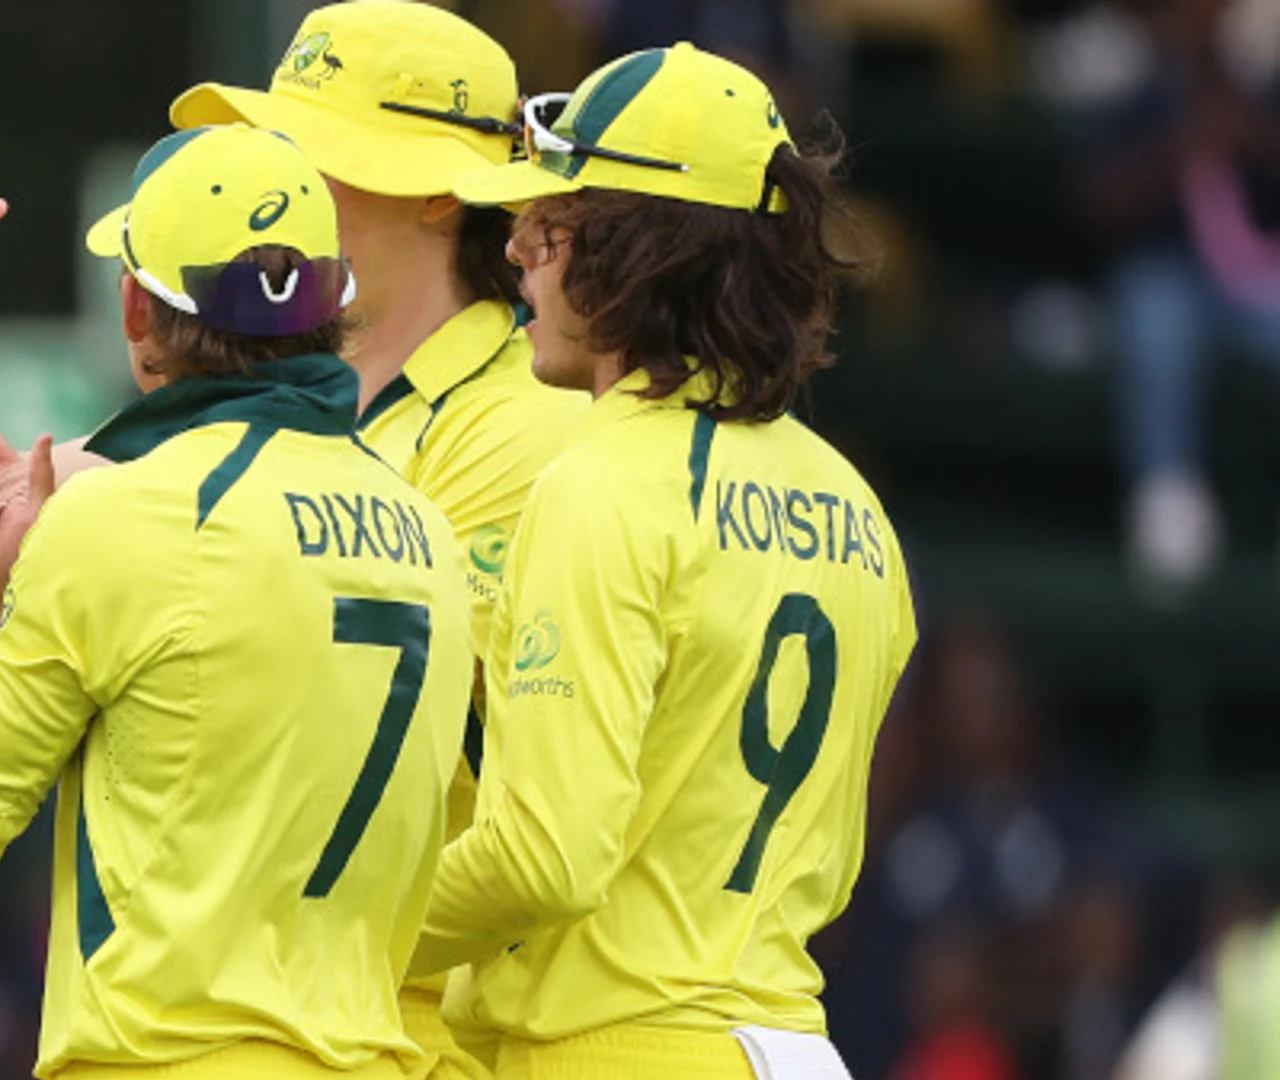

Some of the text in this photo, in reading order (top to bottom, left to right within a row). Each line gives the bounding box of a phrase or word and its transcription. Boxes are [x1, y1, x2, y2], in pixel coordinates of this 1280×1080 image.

[283, 492, 433, 570] DIXON
[716, 480, 884, 579] KONSTAS
[301, 596, 431, 898] 7
[722, 592, 838, 894] 9
